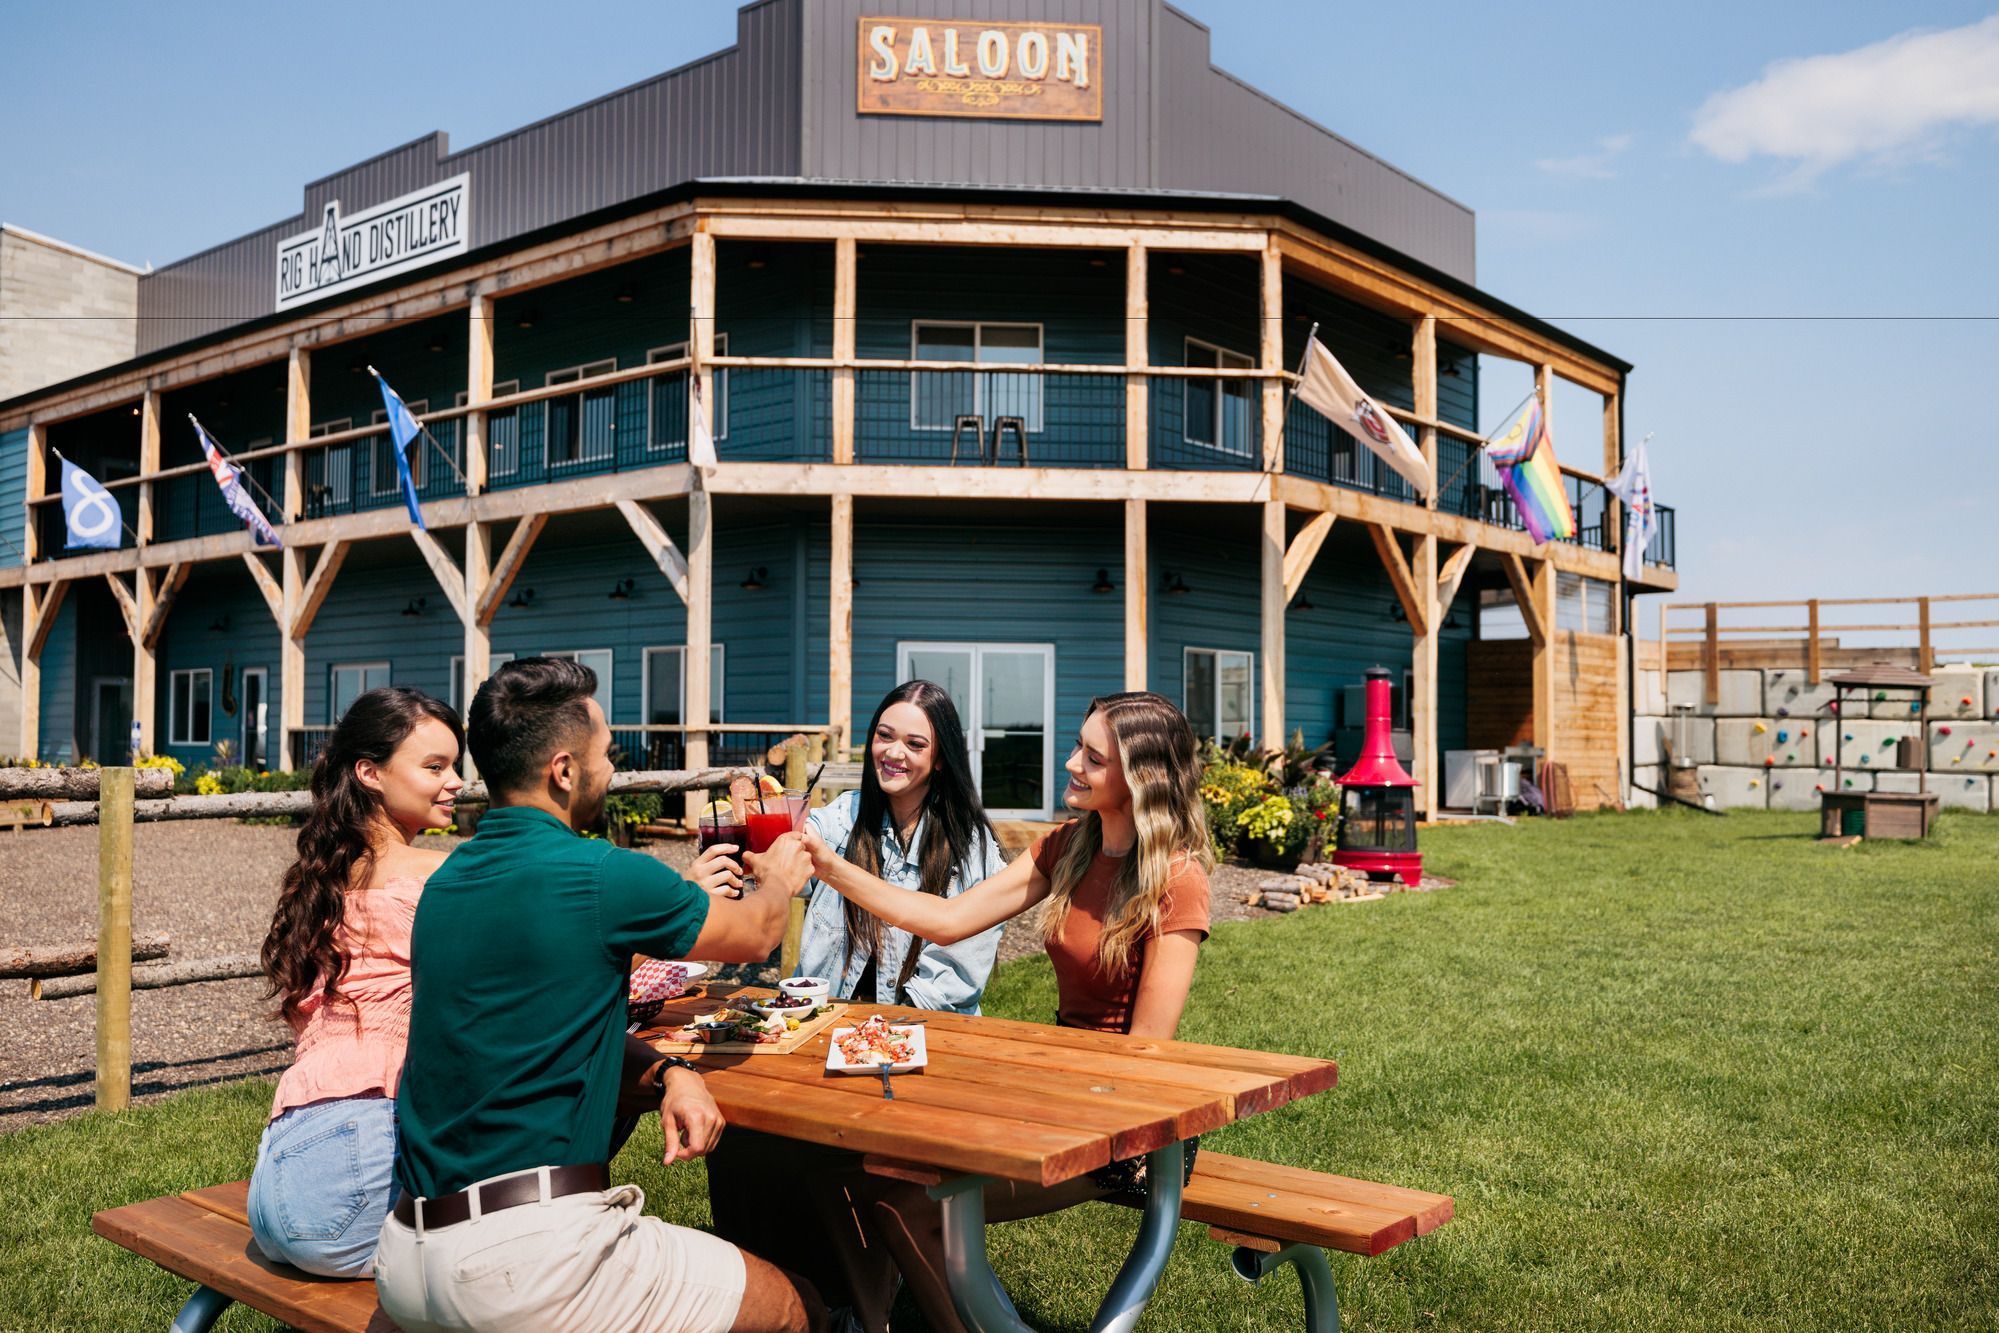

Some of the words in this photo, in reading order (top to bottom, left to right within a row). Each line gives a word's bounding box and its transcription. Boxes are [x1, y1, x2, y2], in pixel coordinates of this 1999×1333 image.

[870, 26, 1089, 89] SALOON
[281, 252, 302, 293] RIG
[309, 207, 361, 288] HAND
[369, 194, 461, 264] DISTILLERY
